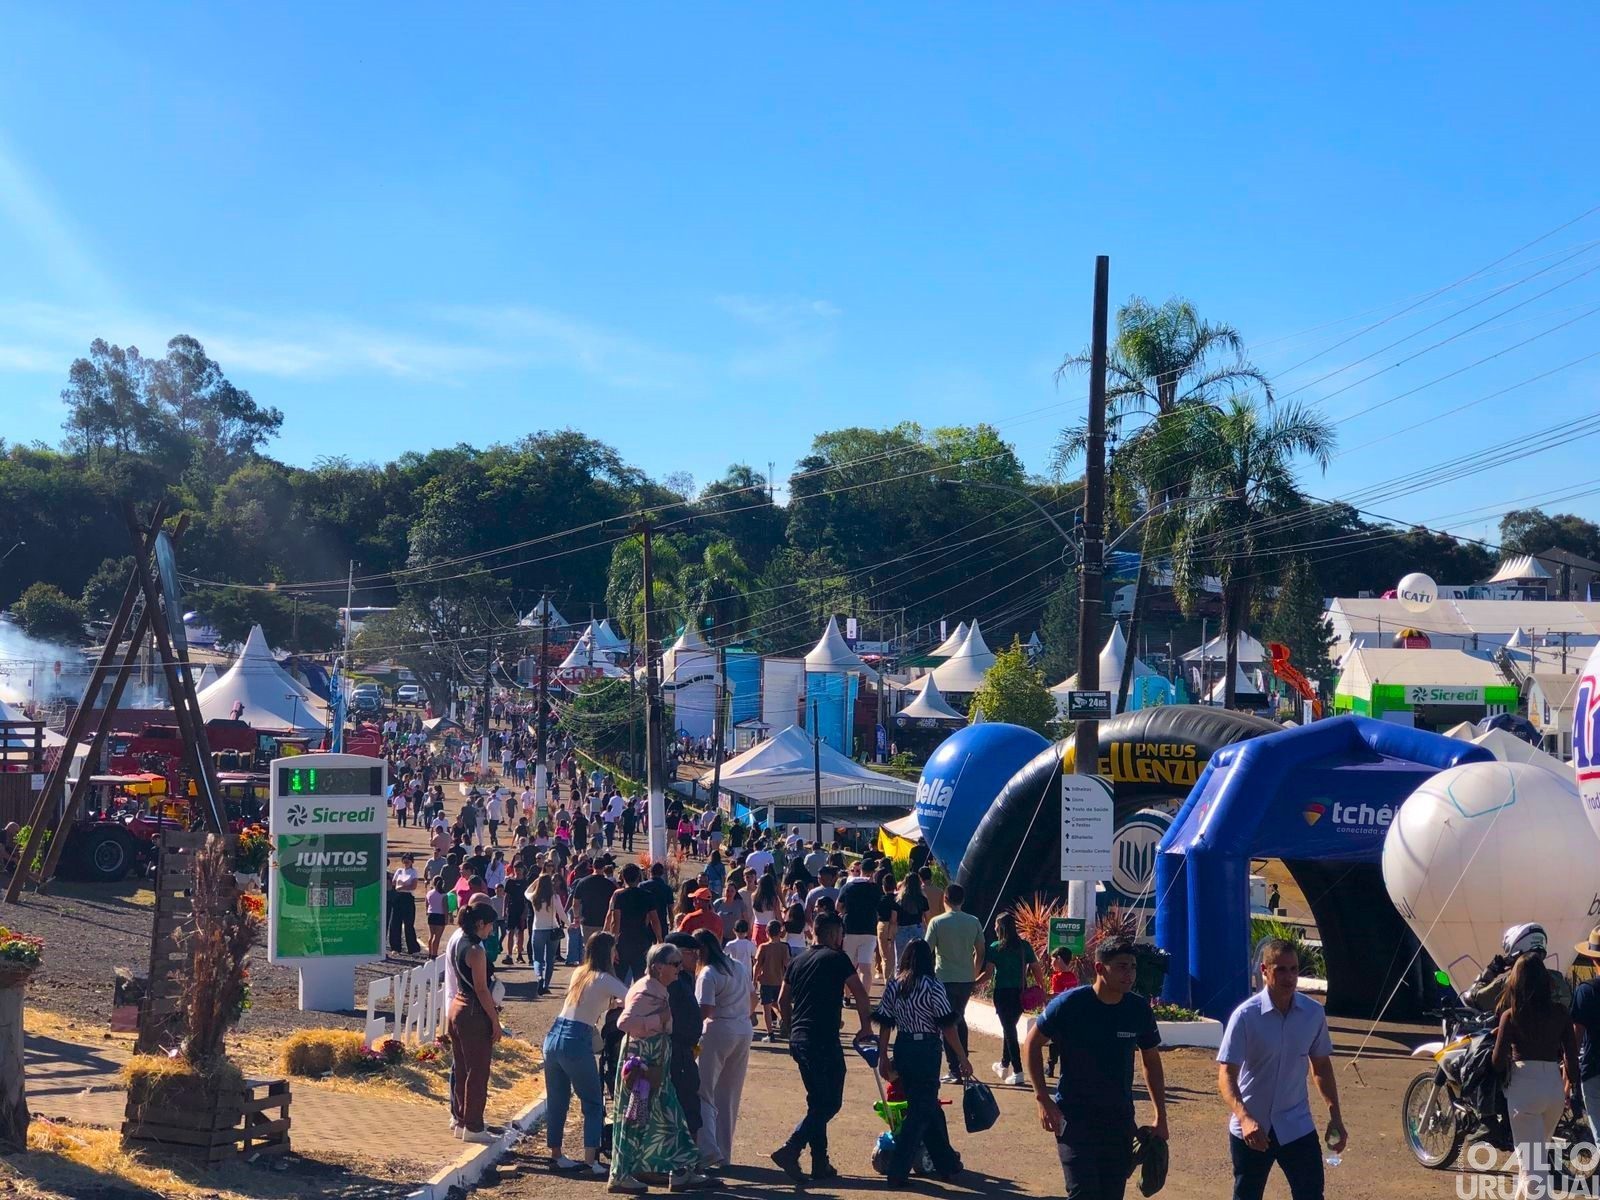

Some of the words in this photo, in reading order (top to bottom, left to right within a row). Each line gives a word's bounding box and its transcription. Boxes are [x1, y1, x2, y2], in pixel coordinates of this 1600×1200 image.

[1401, 589, 1433, 603] ICATU
[1430, 689, 1478, 701] Sicredi
[1136, 743, 1196, 757] PNEUS
[312, 807, 375, 823] Sicredi
[1336, 827, 1378, 835] conectada
[295, 851, 368, 867] JUNTOS
